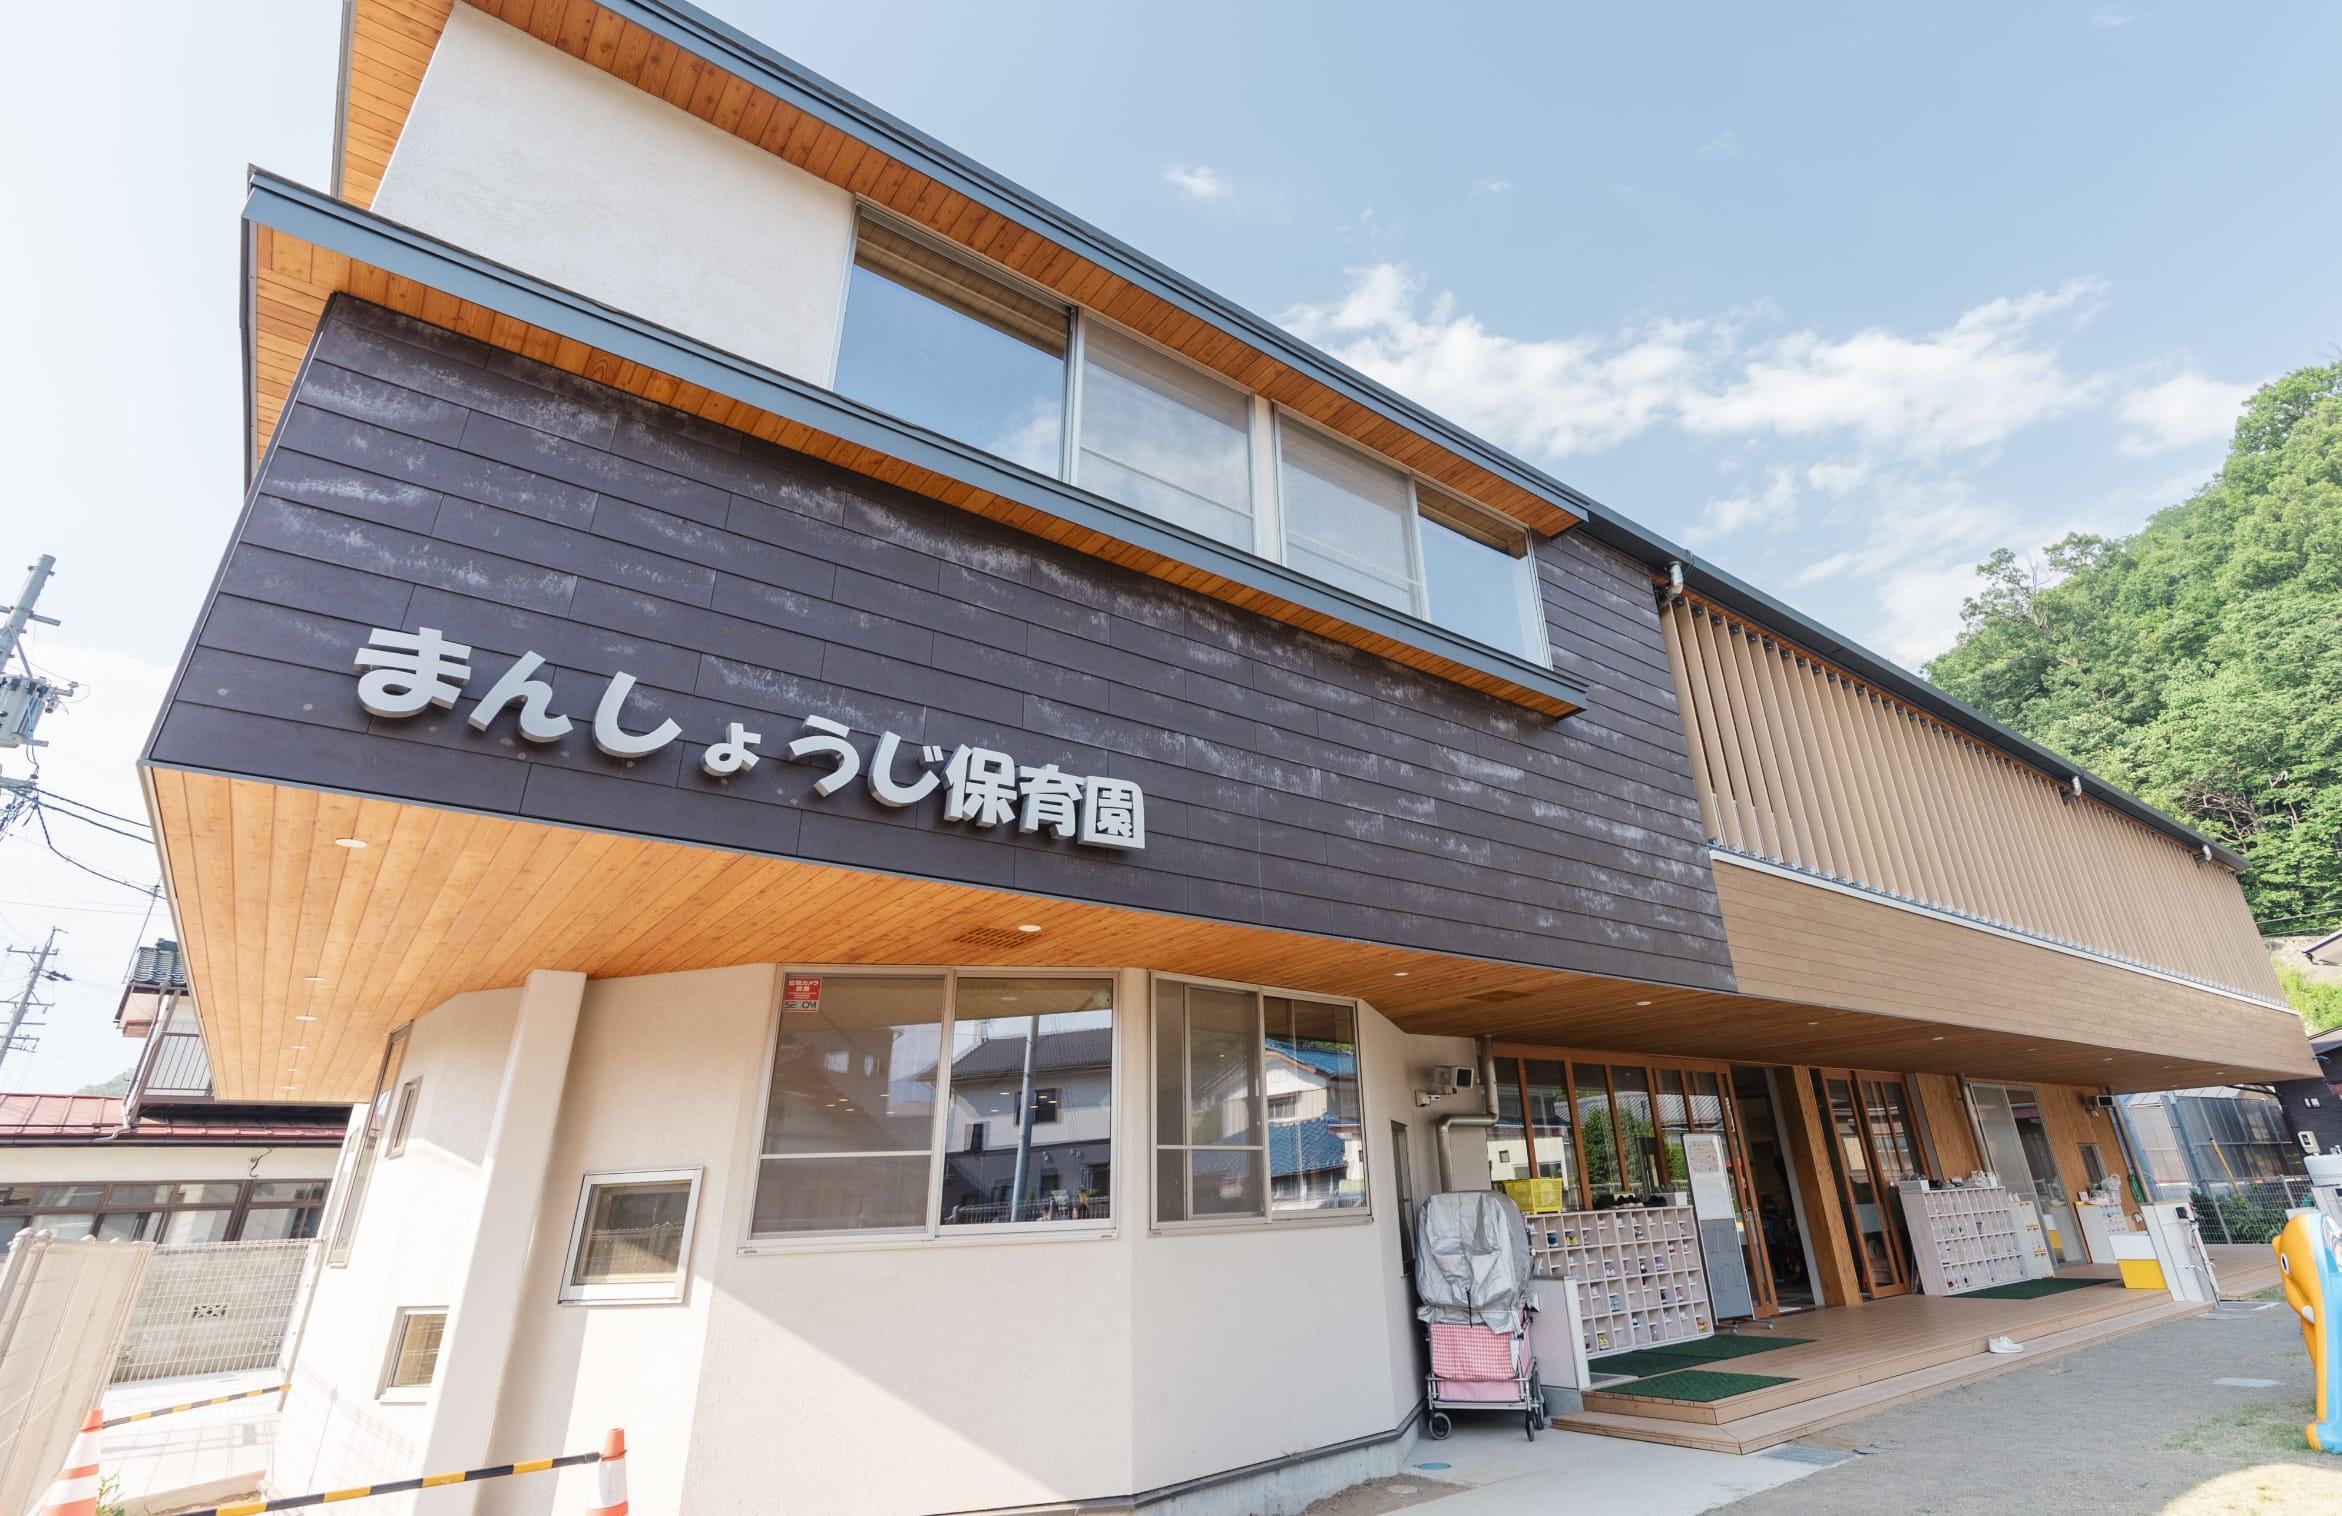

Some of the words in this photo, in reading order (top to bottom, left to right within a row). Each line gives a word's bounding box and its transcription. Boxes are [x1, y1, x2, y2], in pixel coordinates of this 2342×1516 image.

[354, 627, 1146, 849] まんしょうじ保育園
